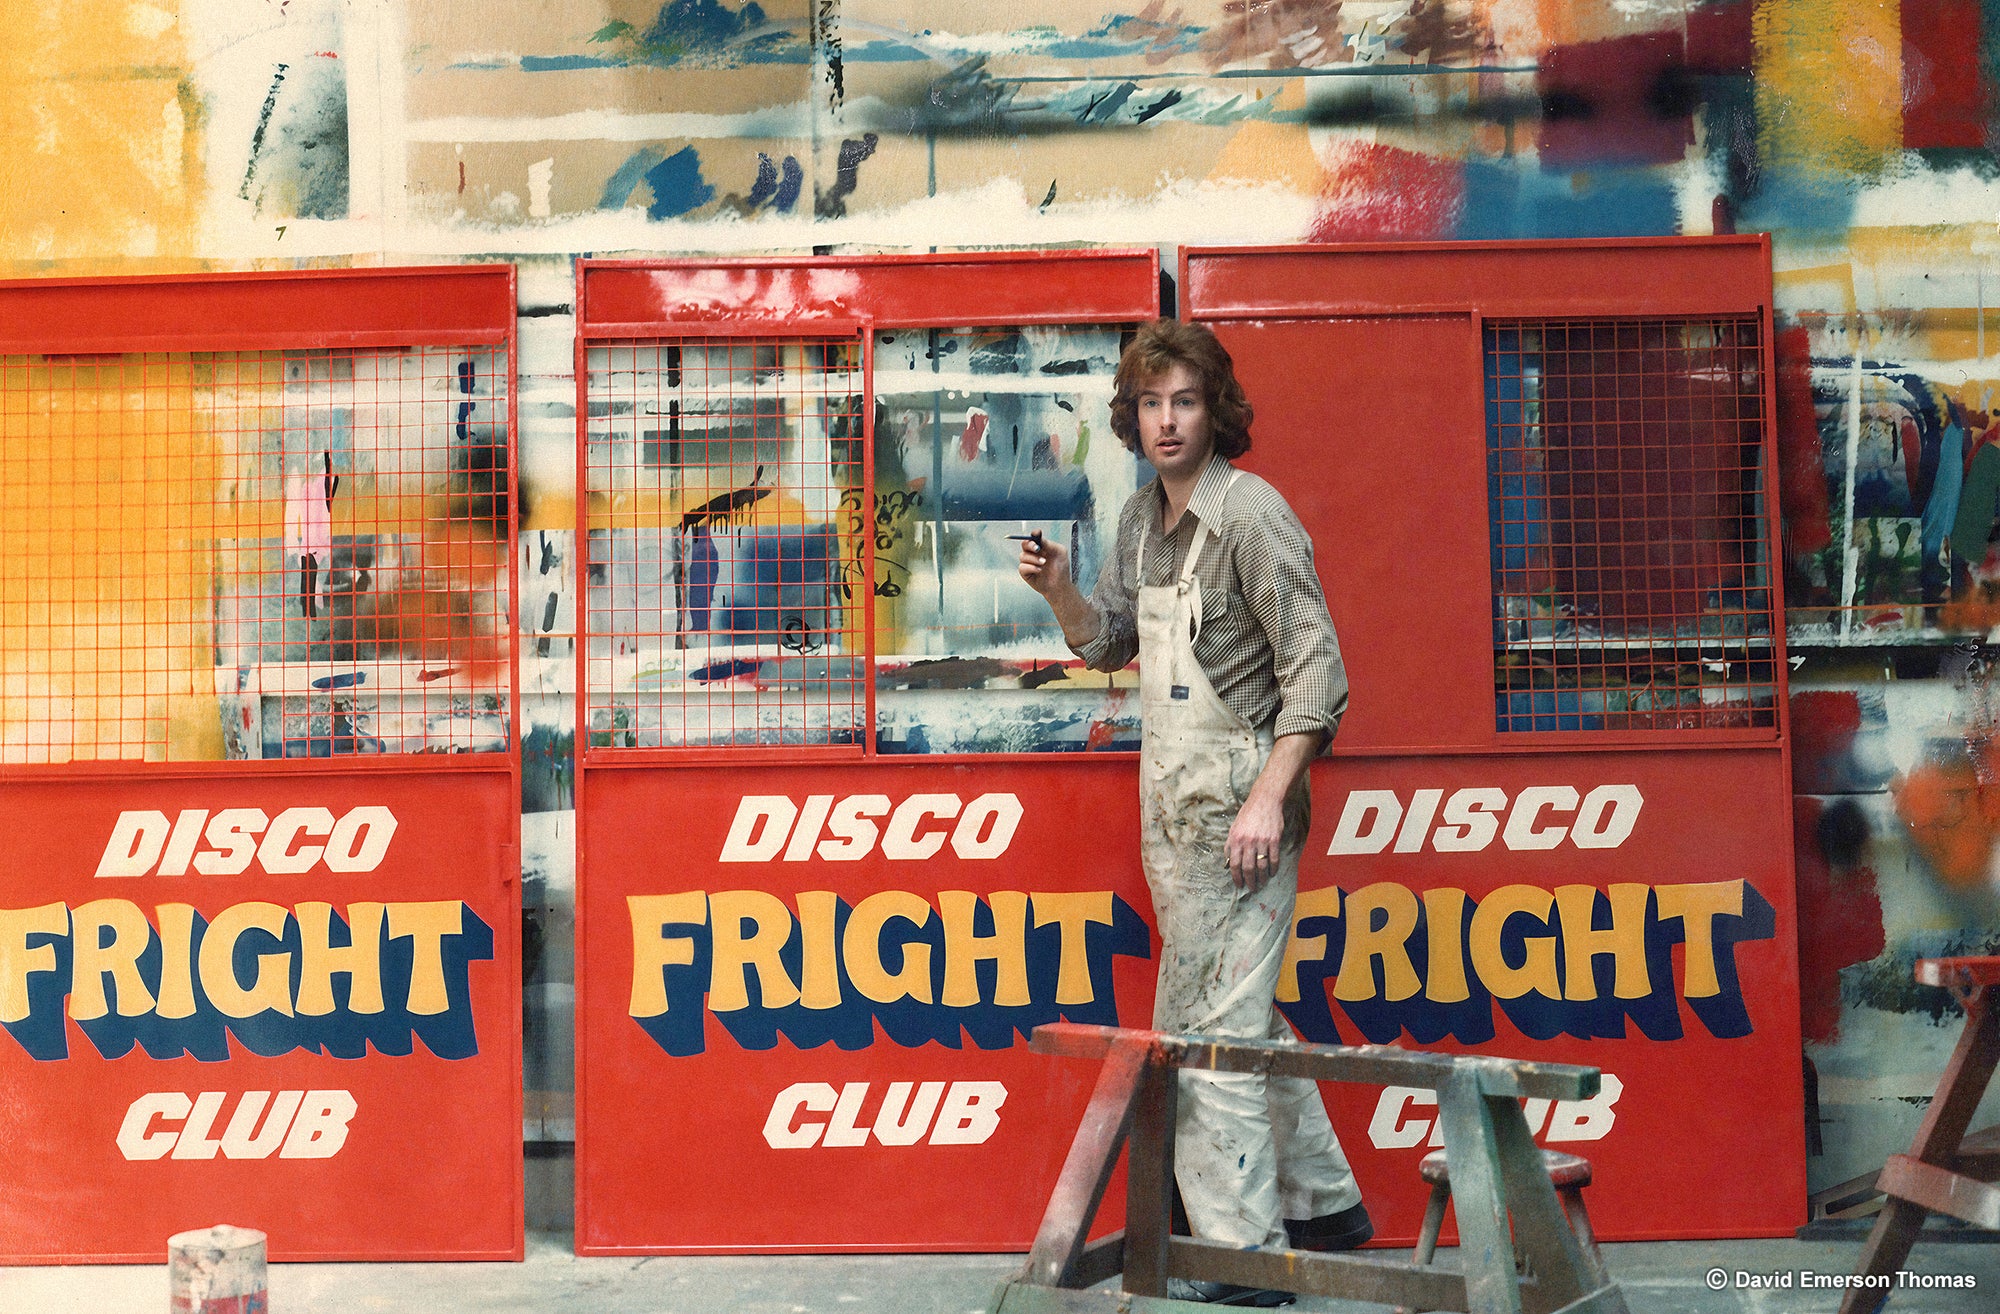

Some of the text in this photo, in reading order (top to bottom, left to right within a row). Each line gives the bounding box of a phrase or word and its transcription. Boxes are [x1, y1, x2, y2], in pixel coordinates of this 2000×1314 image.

[94, 806, 398, 878] DISCO
[719, 793, 1024, 862] DISCO
[1327, 784, 1644, 856] DISCO
[0, 898, 463, 1022] FRIGHT
[626, 890, 1114, 1018] FRIGHT
[1272, 878, 1745, 1004] FRIGHT
[116, 1090, 358, 1160] CLUB
[762, 1081, 1009, 1149] CLUB
[1367, 1073, 1624, 1149] CB
